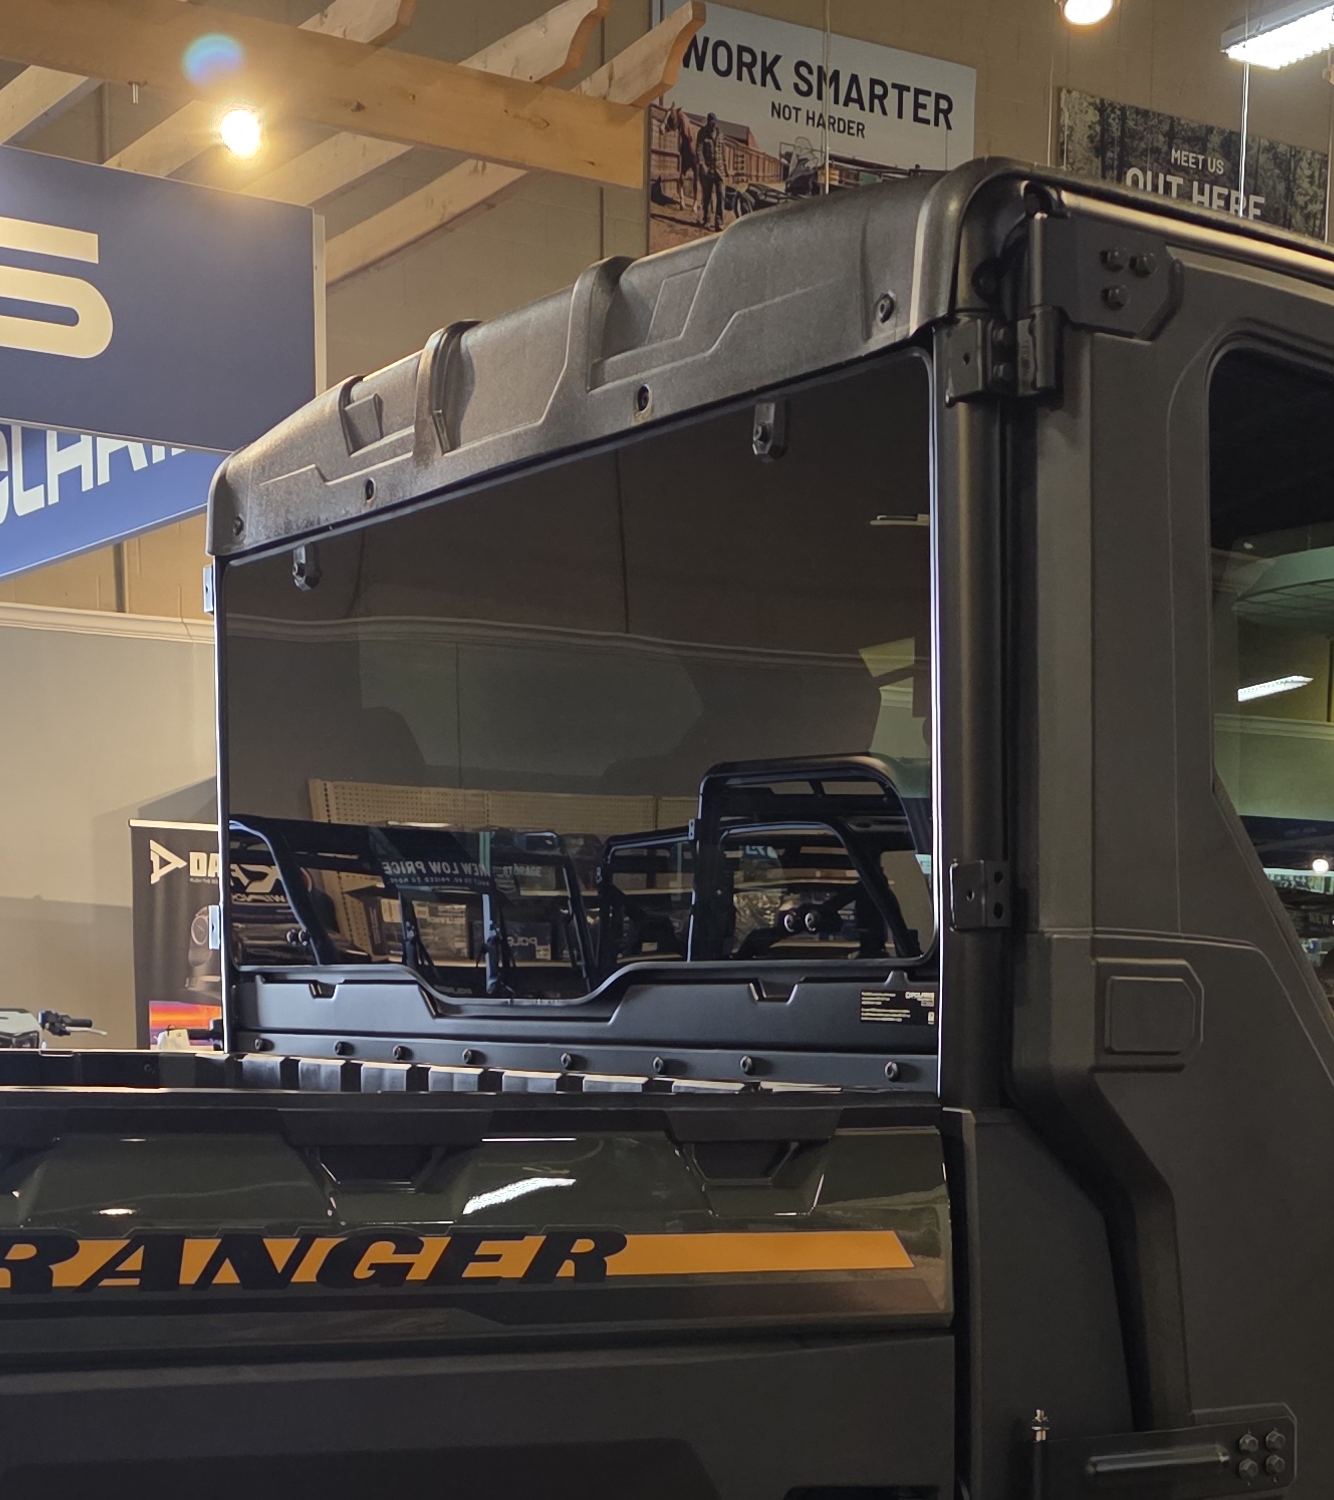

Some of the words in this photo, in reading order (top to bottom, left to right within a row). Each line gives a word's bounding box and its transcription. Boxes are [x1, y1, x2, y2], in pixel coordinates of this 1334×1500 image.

[682, 34, 782, 91] WORK
[793, 60, 954, 131] SMARTER
[771, 101, 802, 123] NOT
[805, 110, 865, 139] HARDER
[1171, 148, 1205, 170] MEET
[1207, 157, 1224, 175] US
